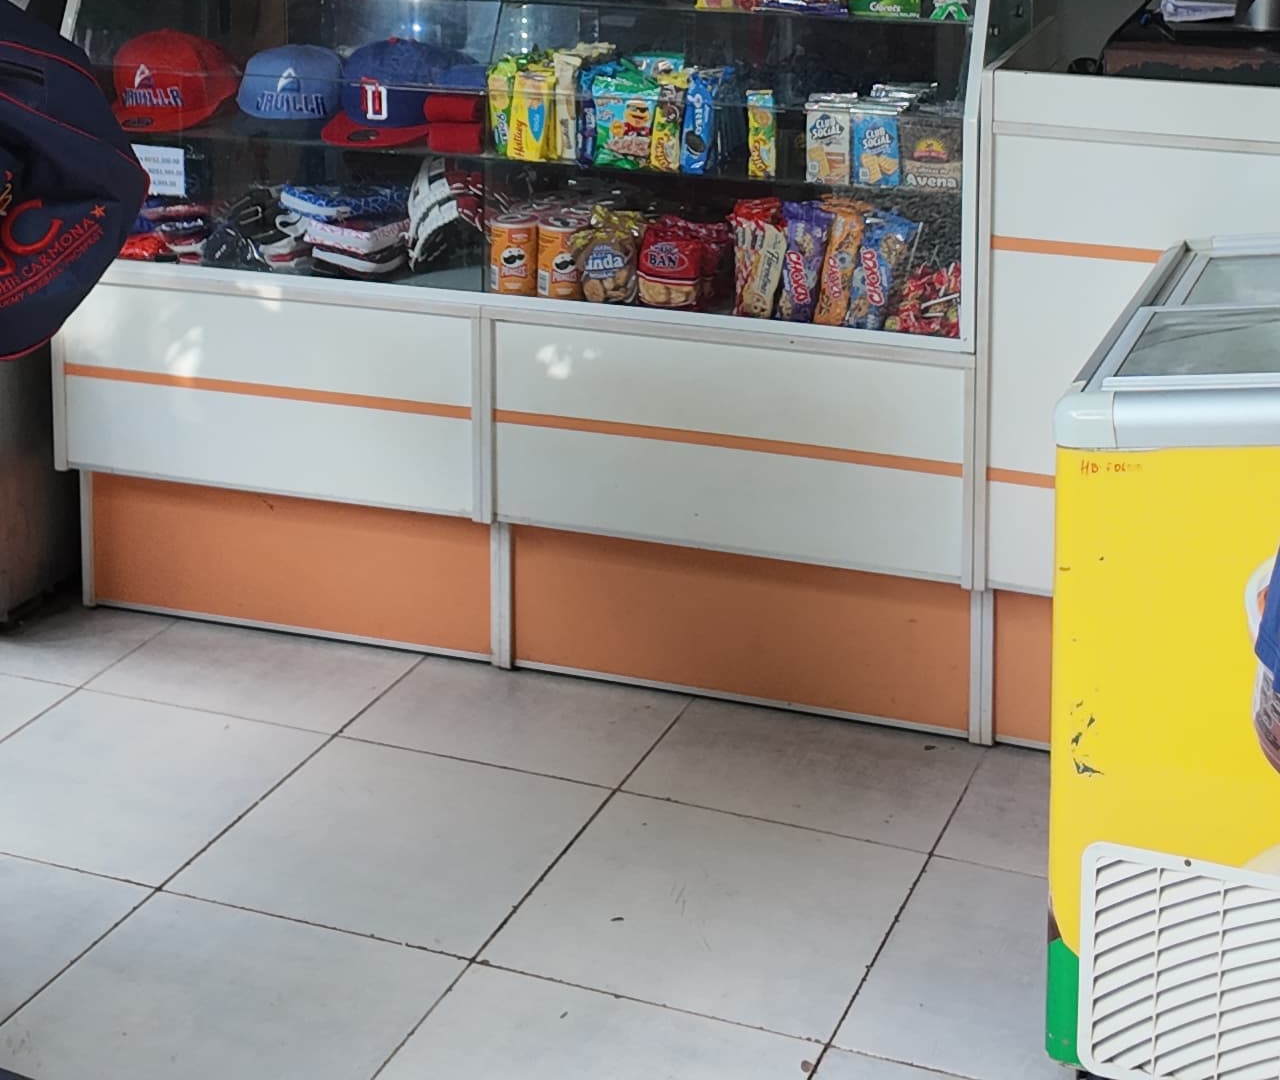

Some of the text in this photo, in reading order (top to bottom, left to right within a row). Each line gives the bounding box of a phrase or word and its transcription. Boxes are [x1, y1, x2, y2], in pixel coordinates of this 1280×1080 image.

[812, 125, 841, 139] SOCIAL
[865, 127, 886, 139] CLUB
[862, 135, 891, 150] SOCIAL
[905, 174, 957, 188] Avena
[21, 216, 96, 278] CARMONA
